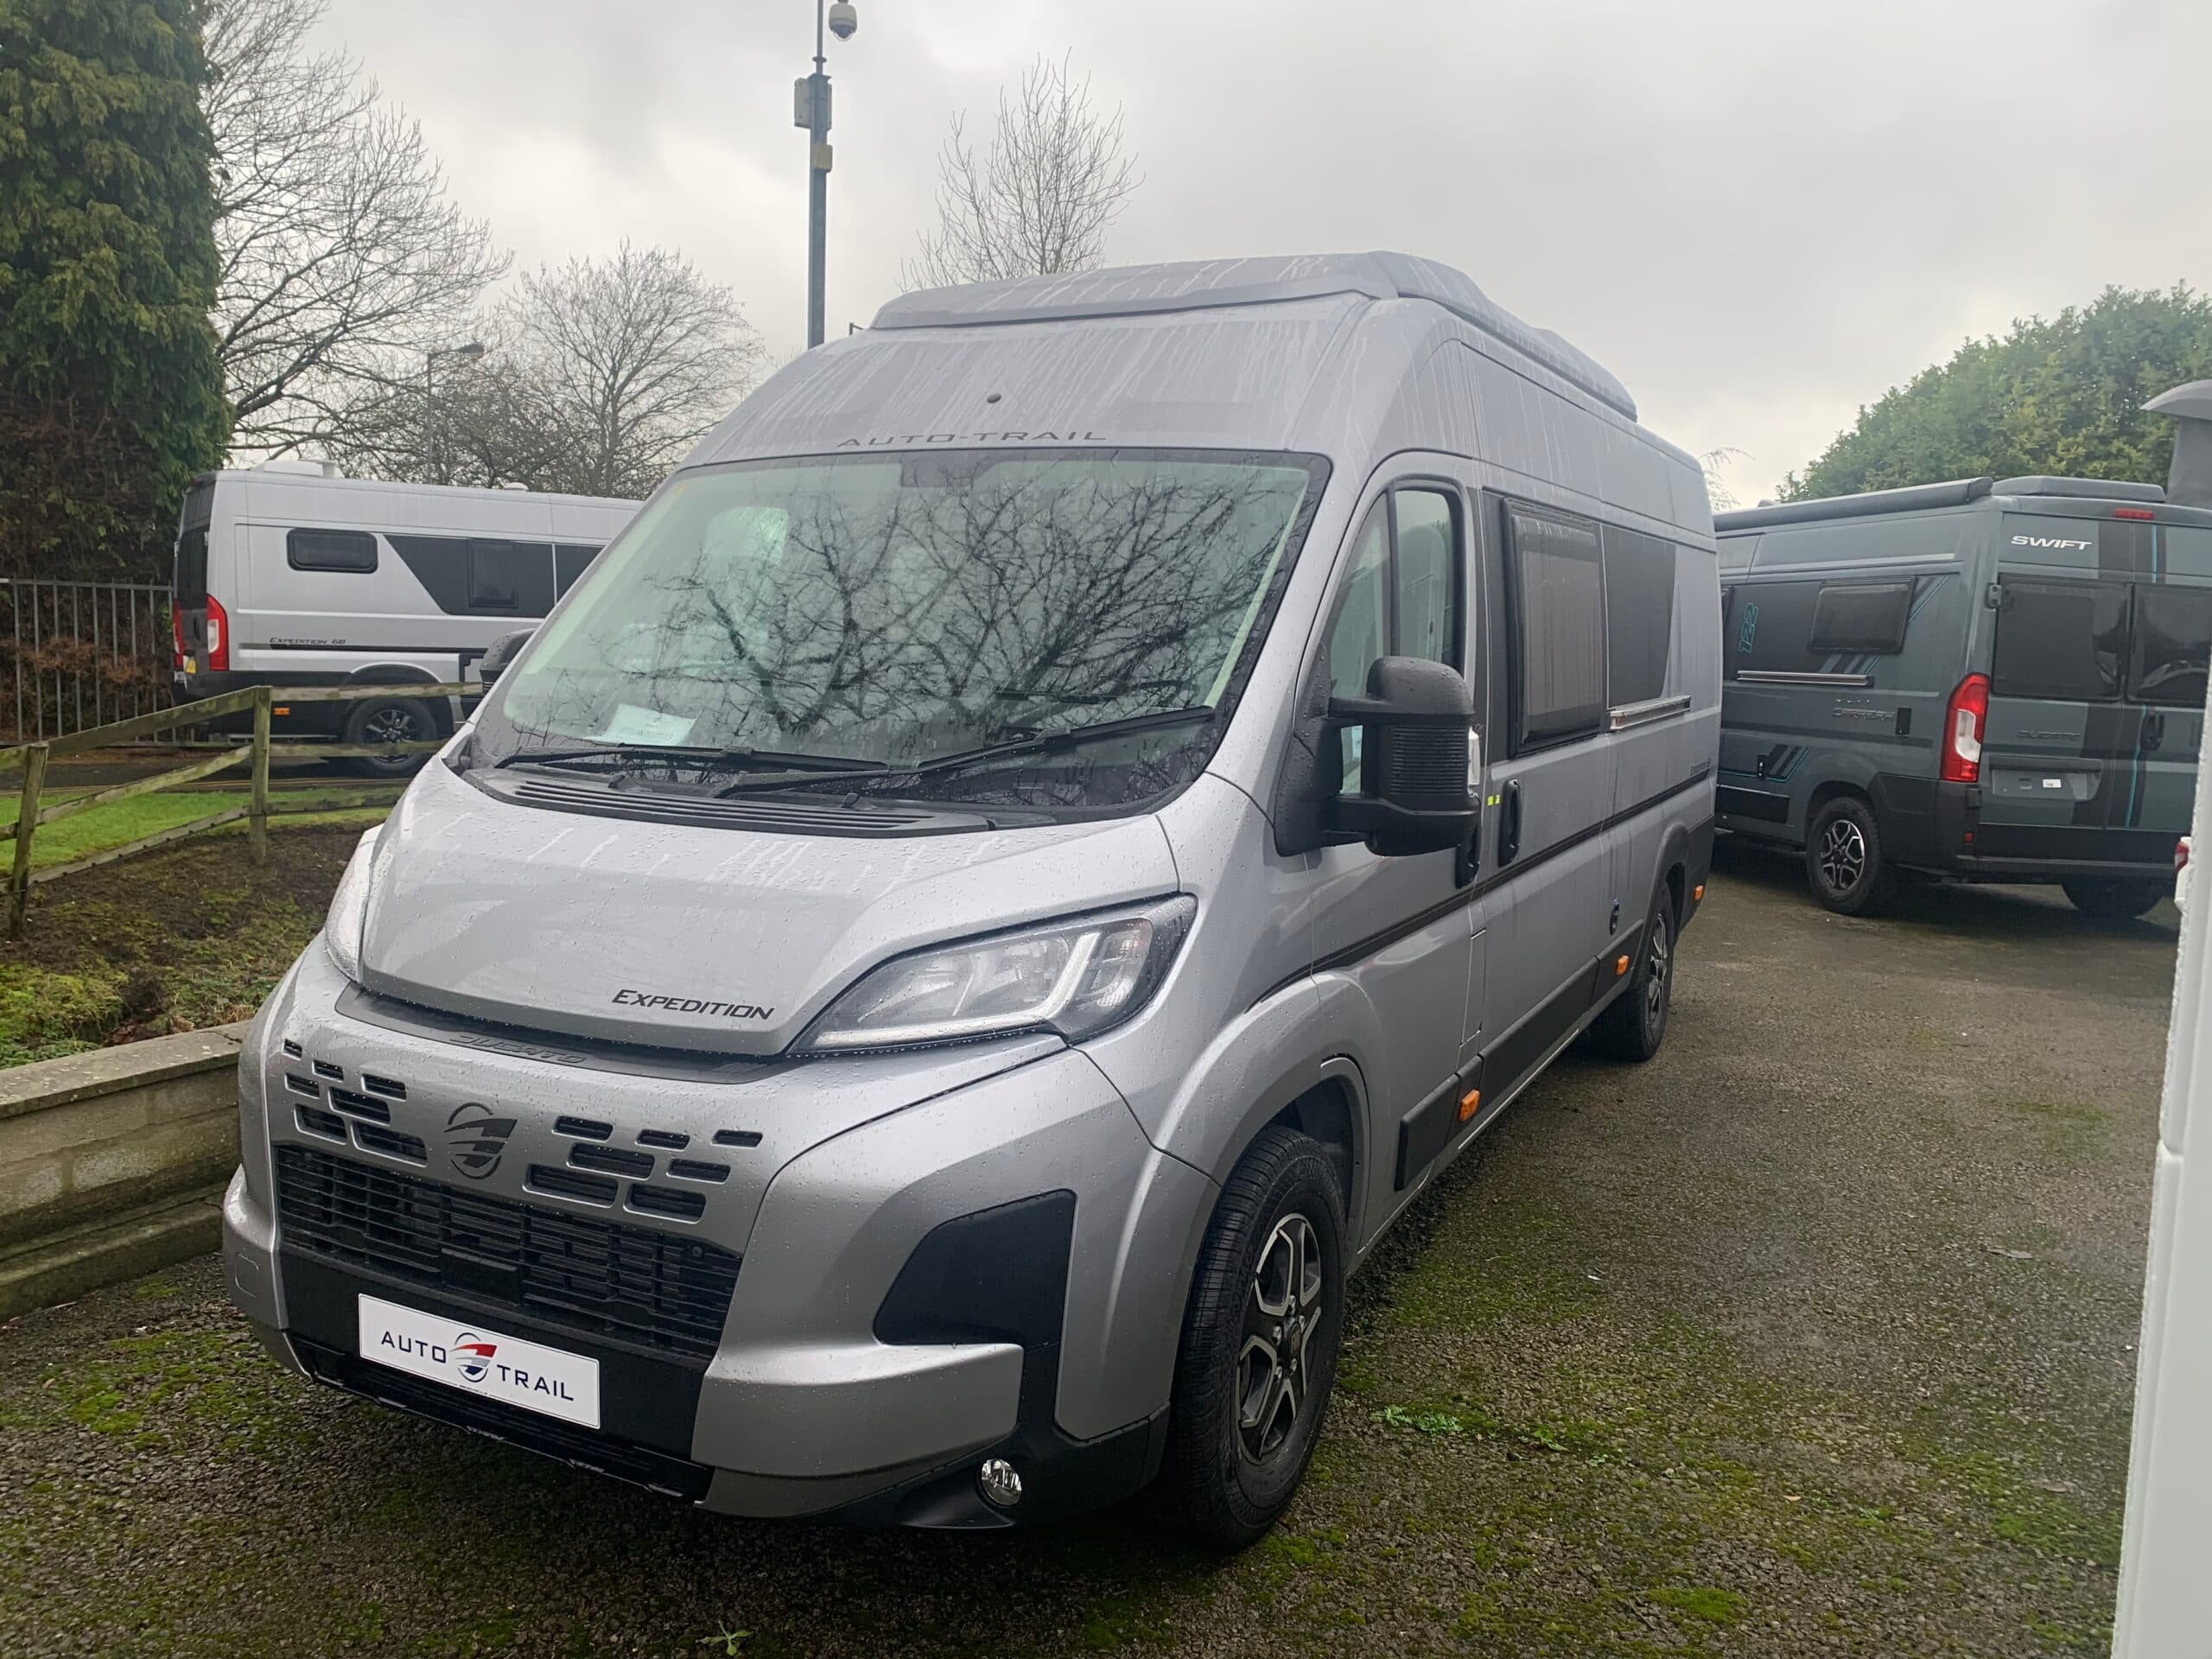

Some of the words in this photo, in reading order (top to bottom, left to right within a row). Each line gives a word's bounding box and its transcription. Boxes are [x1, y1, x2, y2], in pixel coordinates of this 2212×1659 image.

[836, 431, 1108, 448] AUTO-TRAIL
[2011, 535, 2093, 550] SWIFT
[612, 988, 775, 1020] EXPEDITION
[380, 1330, 448, 1365] AUTO
[496, 1363, 575, 1402] TRAIL
